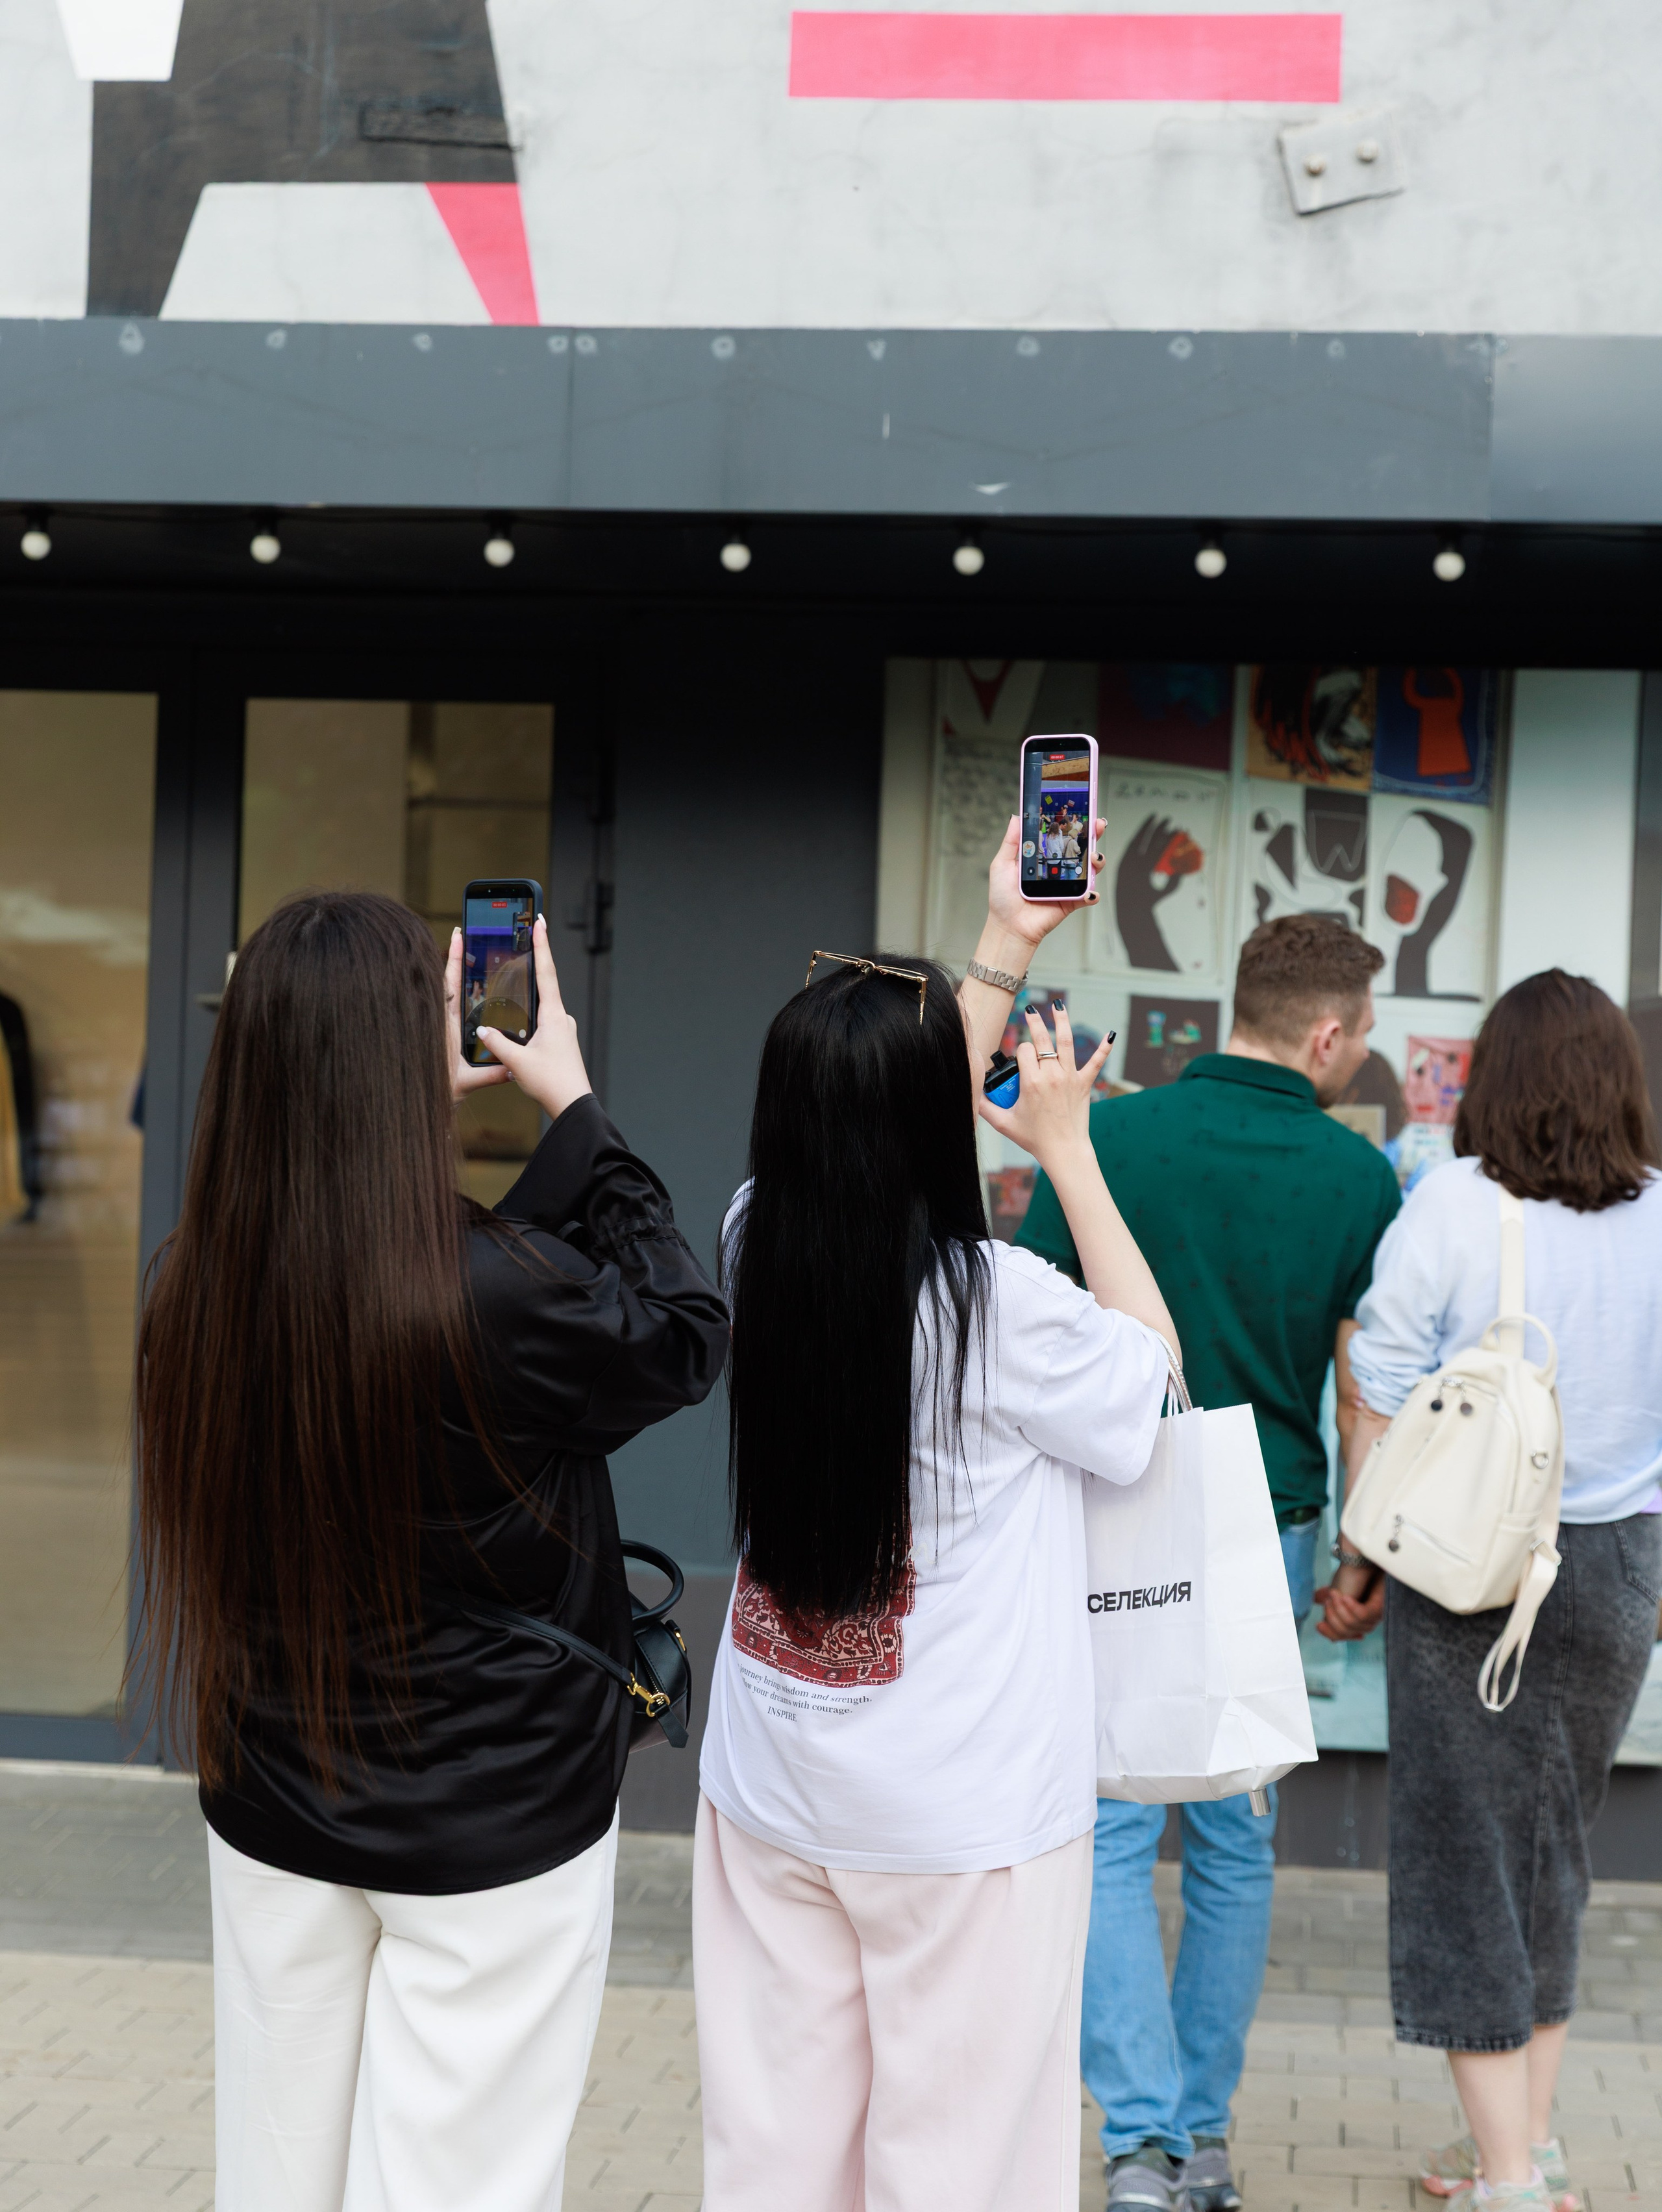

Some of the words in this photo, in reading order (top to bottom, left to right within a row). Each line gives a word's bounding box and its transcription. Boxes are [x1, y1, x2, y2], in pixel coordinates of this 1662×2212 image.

[1087, 1581, 1191, 1613] СЕЛЕКЦИЯ
[752, 1685, 769, 1697] your
[770, 1691, 791, 1706] dreams
[792, 1700, 810, 1709] with
[812, 1705, 852, 1715] courage.
[763, 1675, 781, 1691] brings
[782, 1685, 809, 1698] wisdom
[811, 1692, 829, 1700] and
[830, 1696, 872, 1706] strength.
[767, 1706, 797, 1722] INSPIRE
